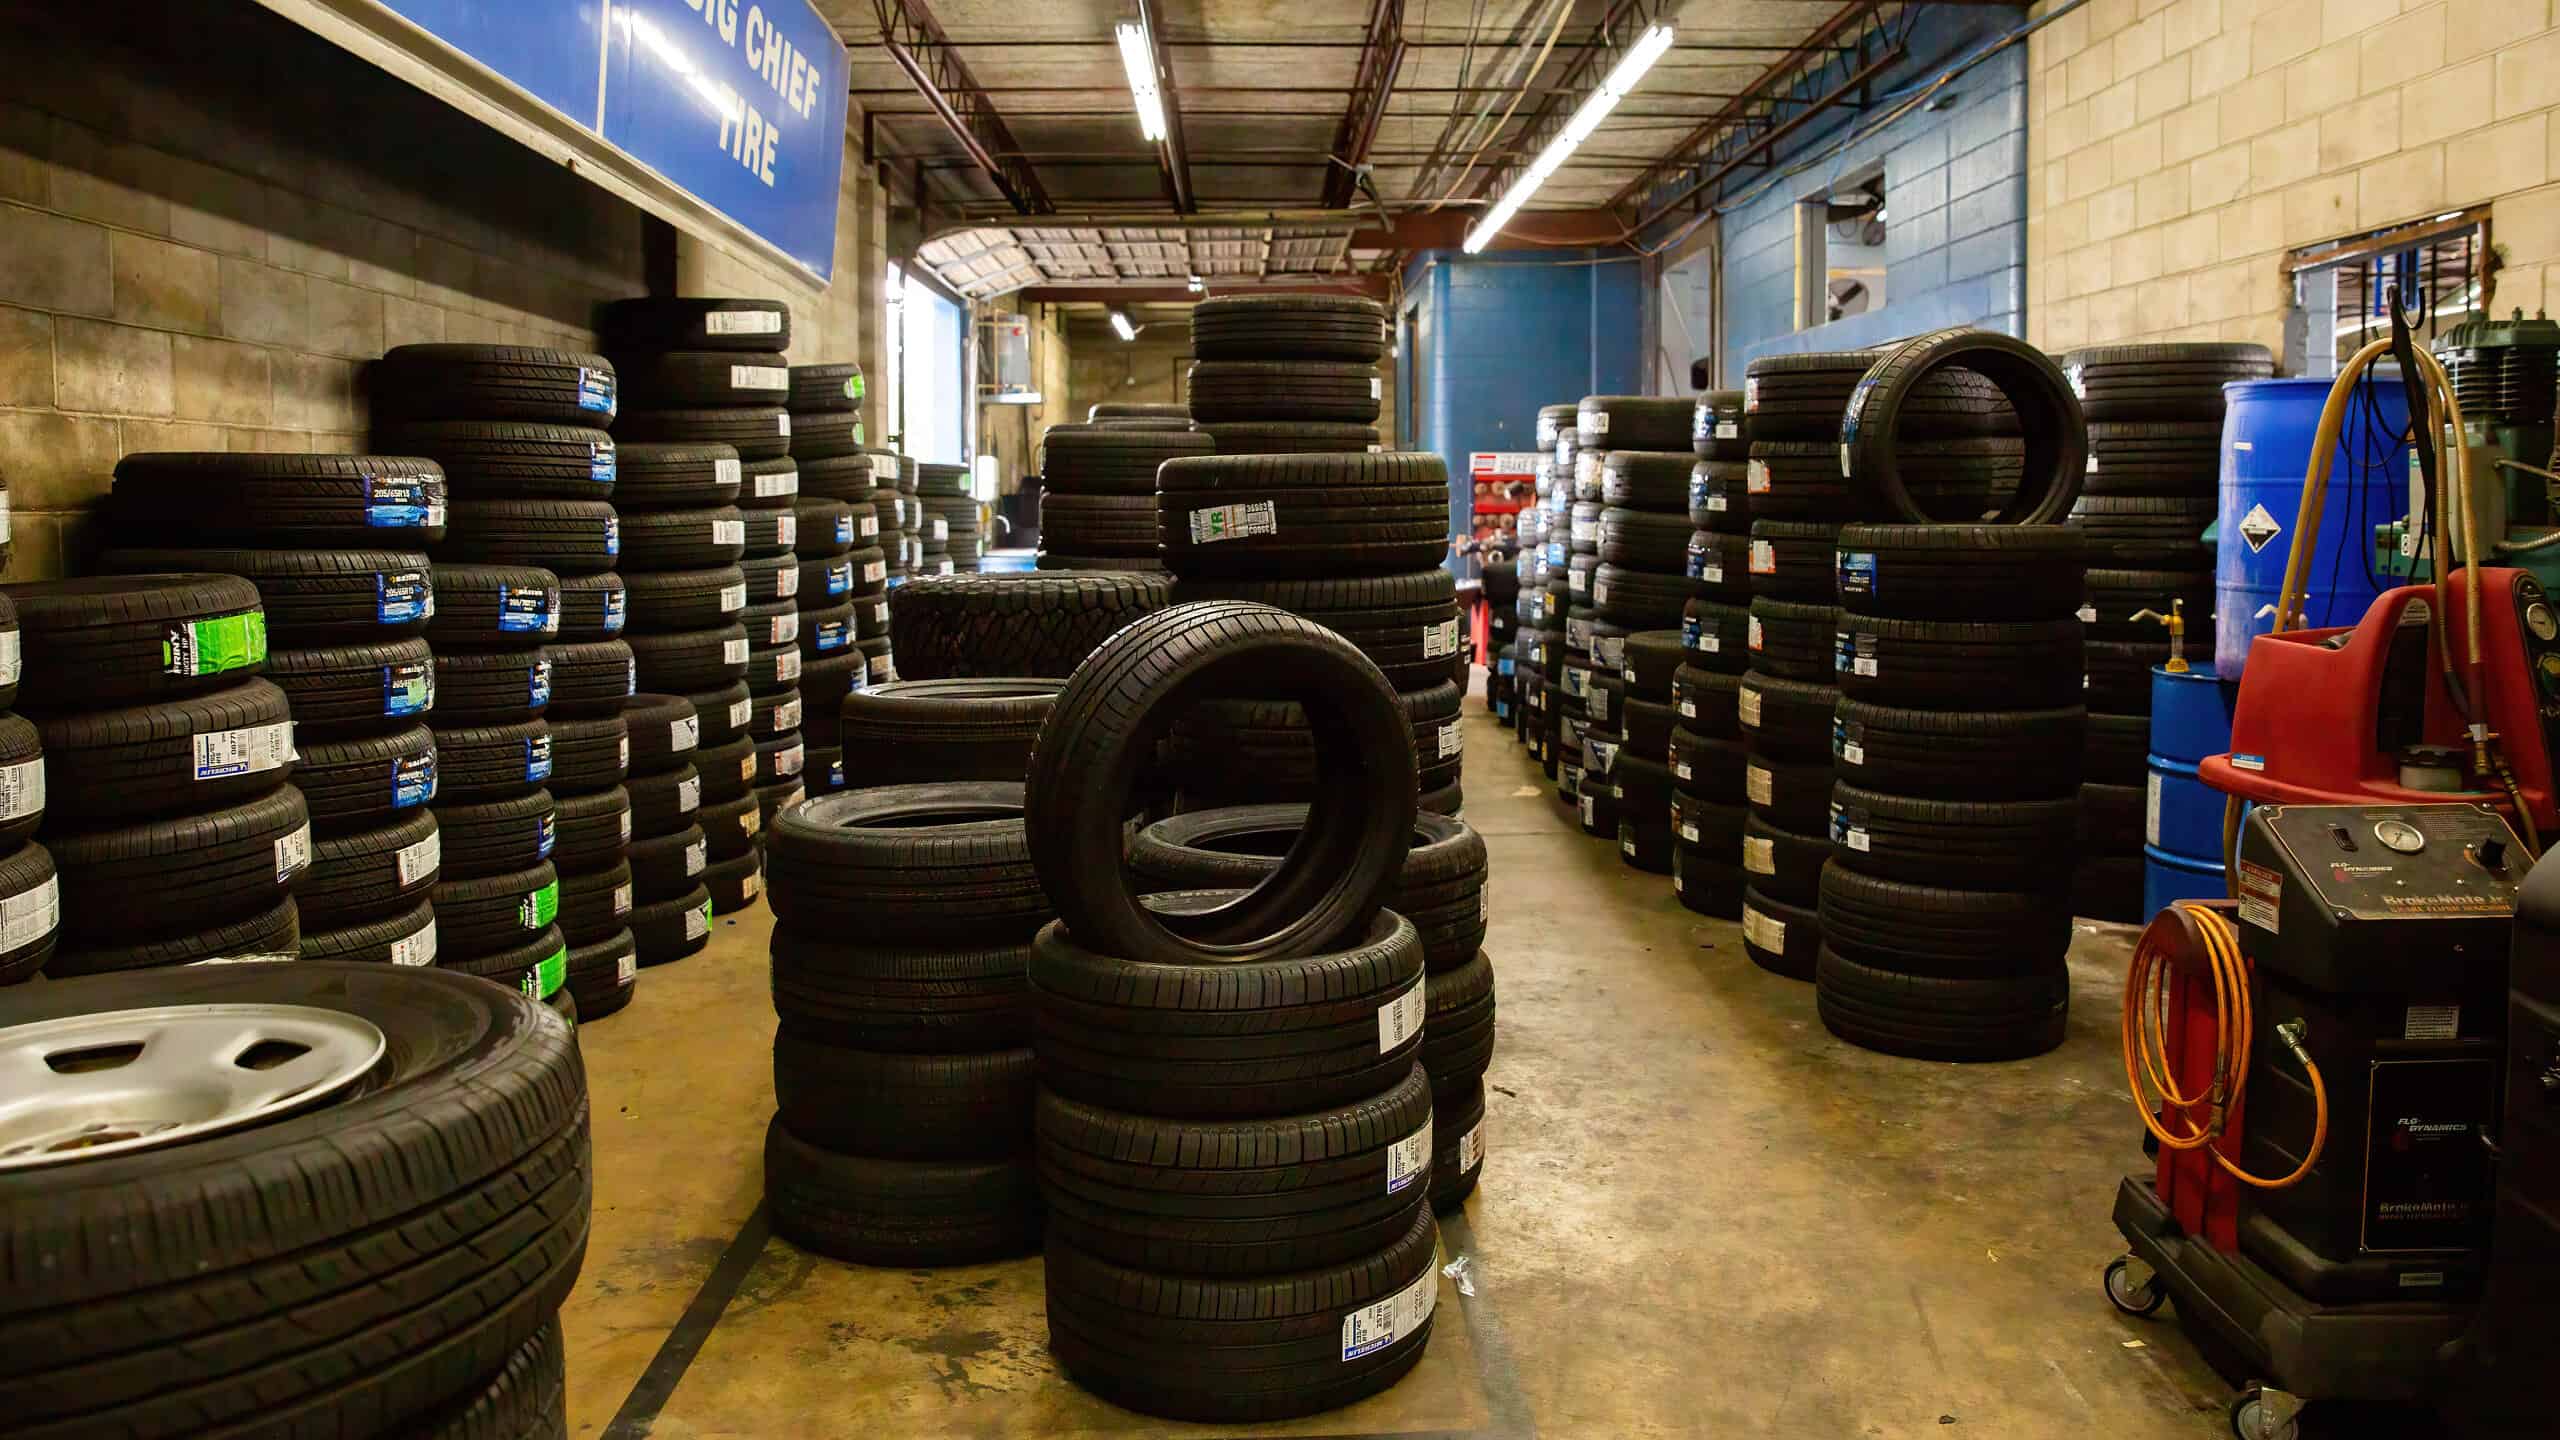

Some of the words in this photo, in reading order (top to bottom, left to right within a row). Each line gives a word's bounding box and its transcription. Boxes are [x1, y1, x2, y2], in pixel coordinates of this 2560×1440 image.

[745, 5, 821, 120] CHIEF
[719, 80, 780, 188] TIRE
[170, 629, 182, 674] PRINX
[2409, 1124, 2467, 1132] DYNAMICS
